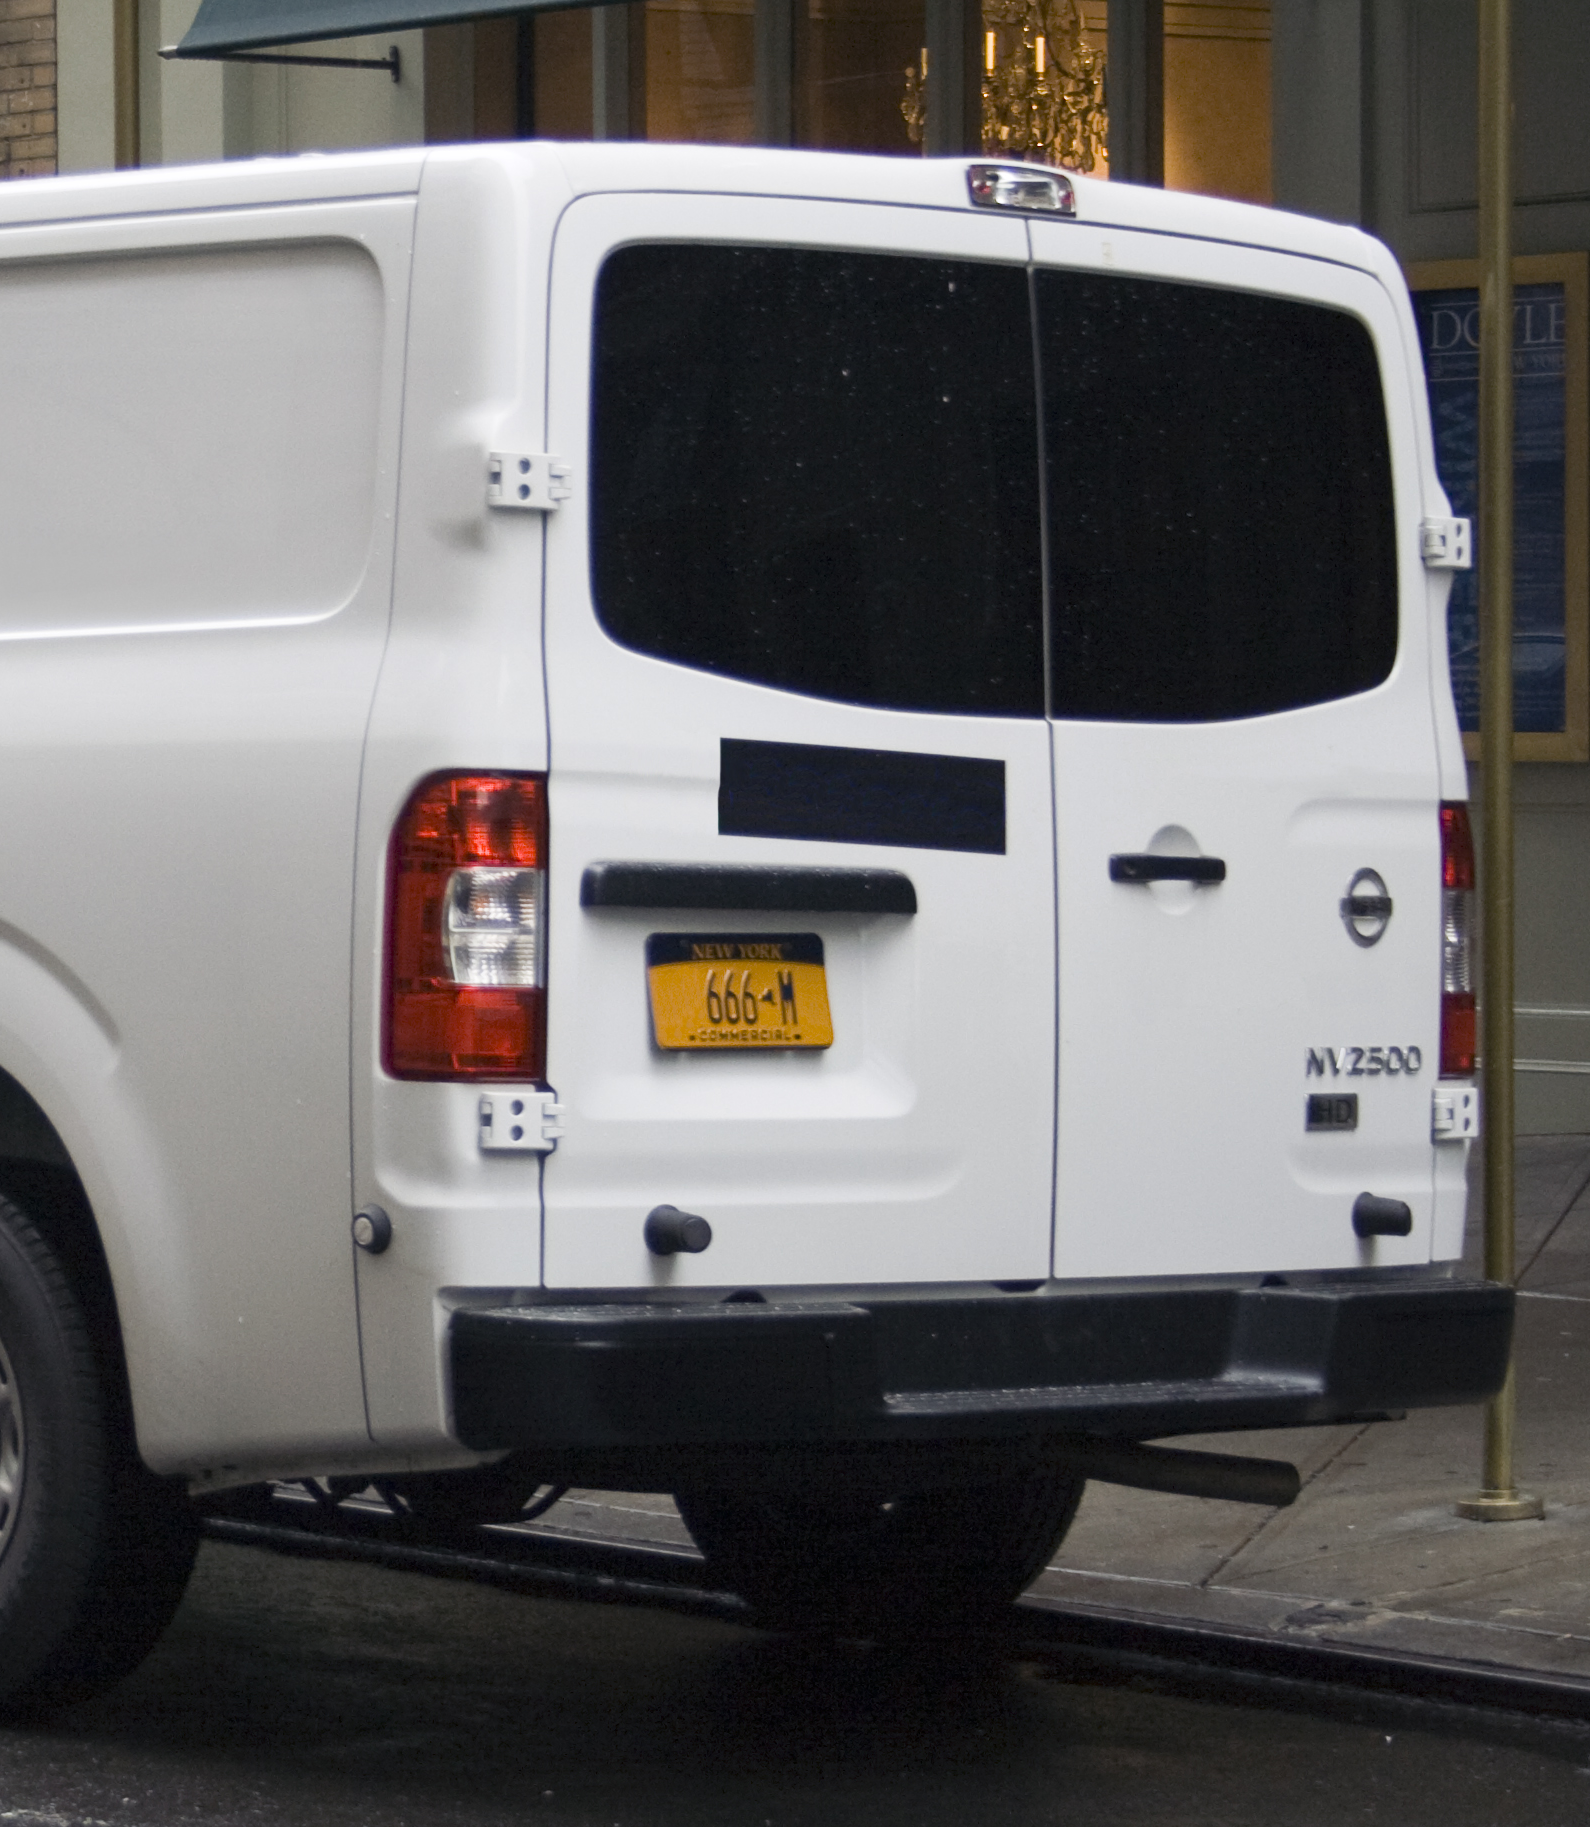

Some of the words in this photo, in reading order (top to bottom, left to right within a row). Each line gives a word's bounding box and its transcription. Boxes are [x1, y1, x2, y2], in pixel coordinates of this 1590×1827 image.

[691, 944, 734, 960] NEW
[737, 943, 782, 960] YORK
[706, 970, 758, 1024] 666
[697, 1028, 791, 1041] COMMERCIAL
[1306, 1046, 1421, 1077] NV2500
